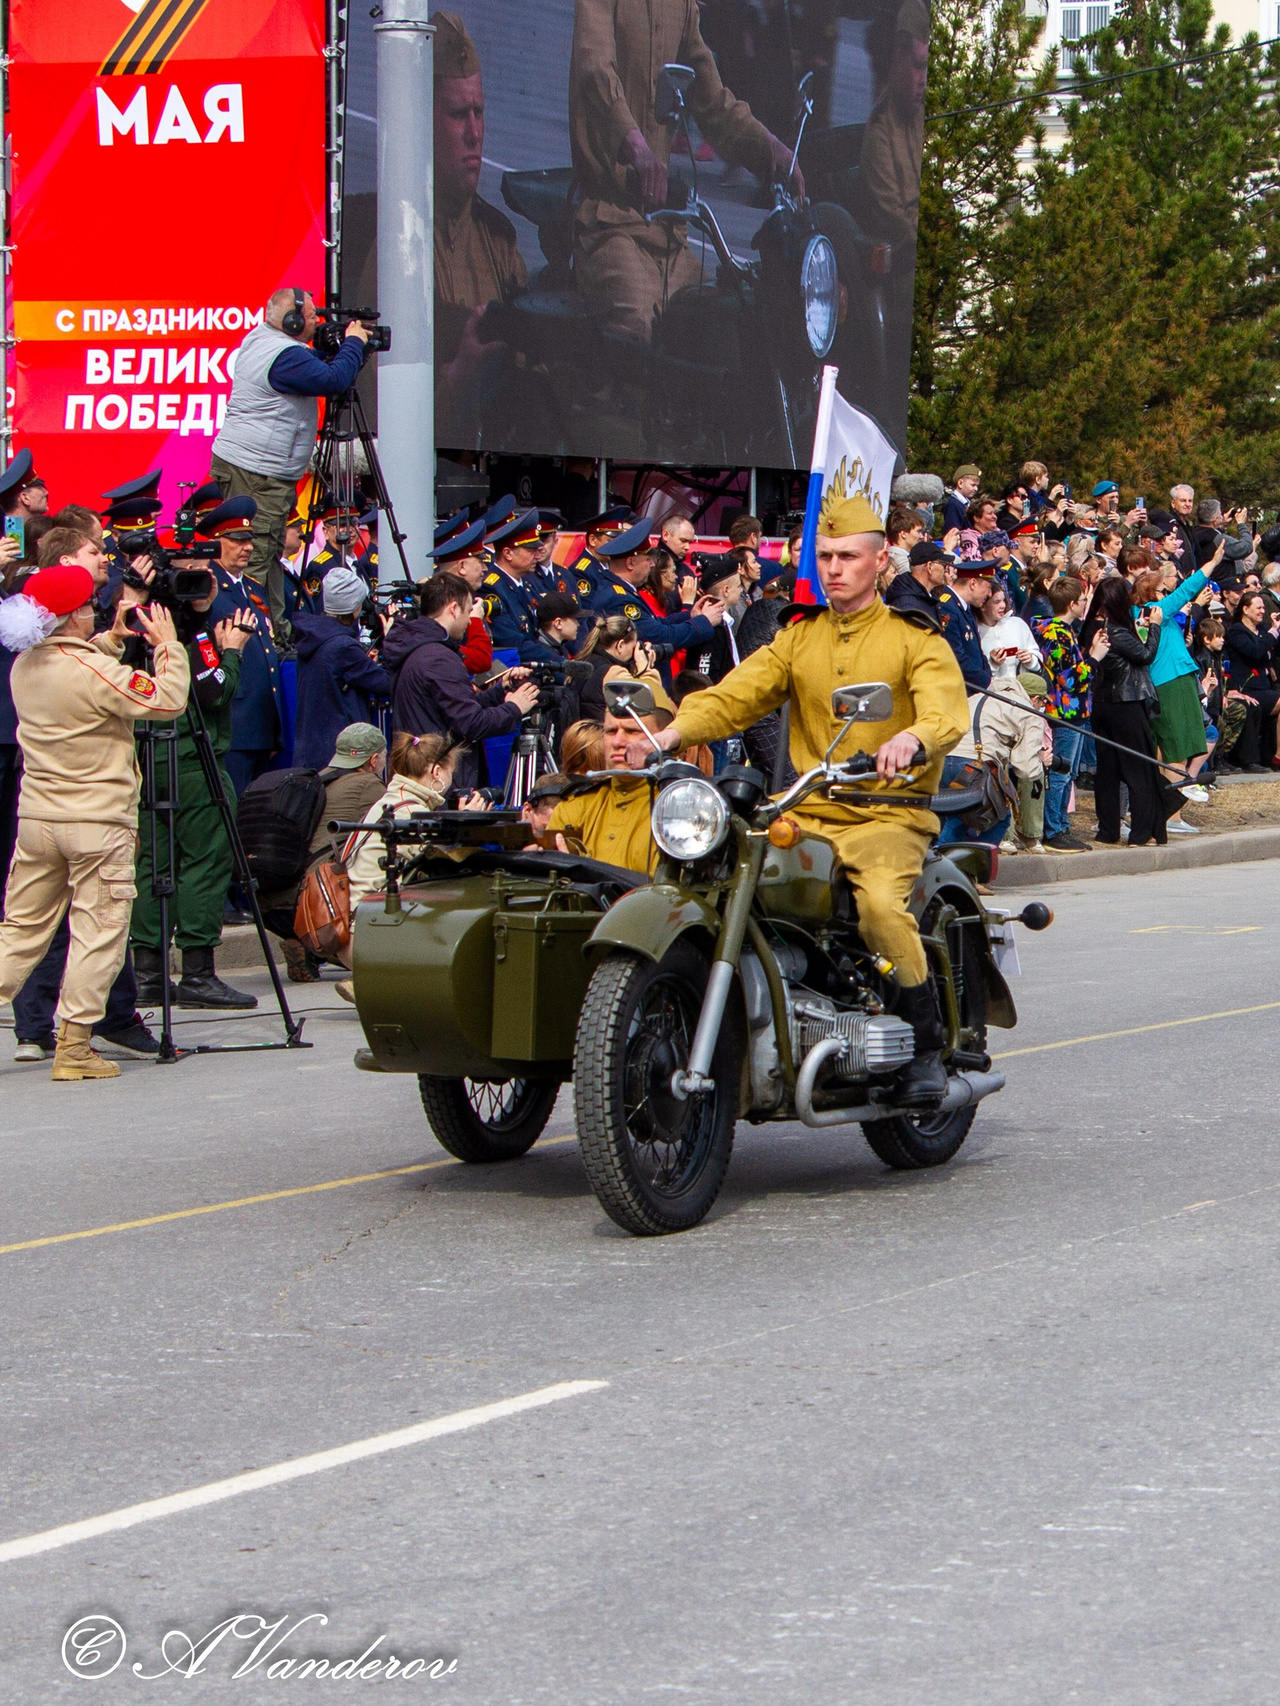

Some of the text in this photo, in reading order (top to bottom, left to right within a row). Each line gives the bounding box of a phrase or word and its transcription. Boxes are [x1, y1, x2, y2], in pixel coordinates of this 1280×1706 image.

[95, 83, 245, 146] МАЯ
[55, 307, 264, 335] С ПРАЗДНИКОМ
[64, 394, 230, 436] ПОБЕД
